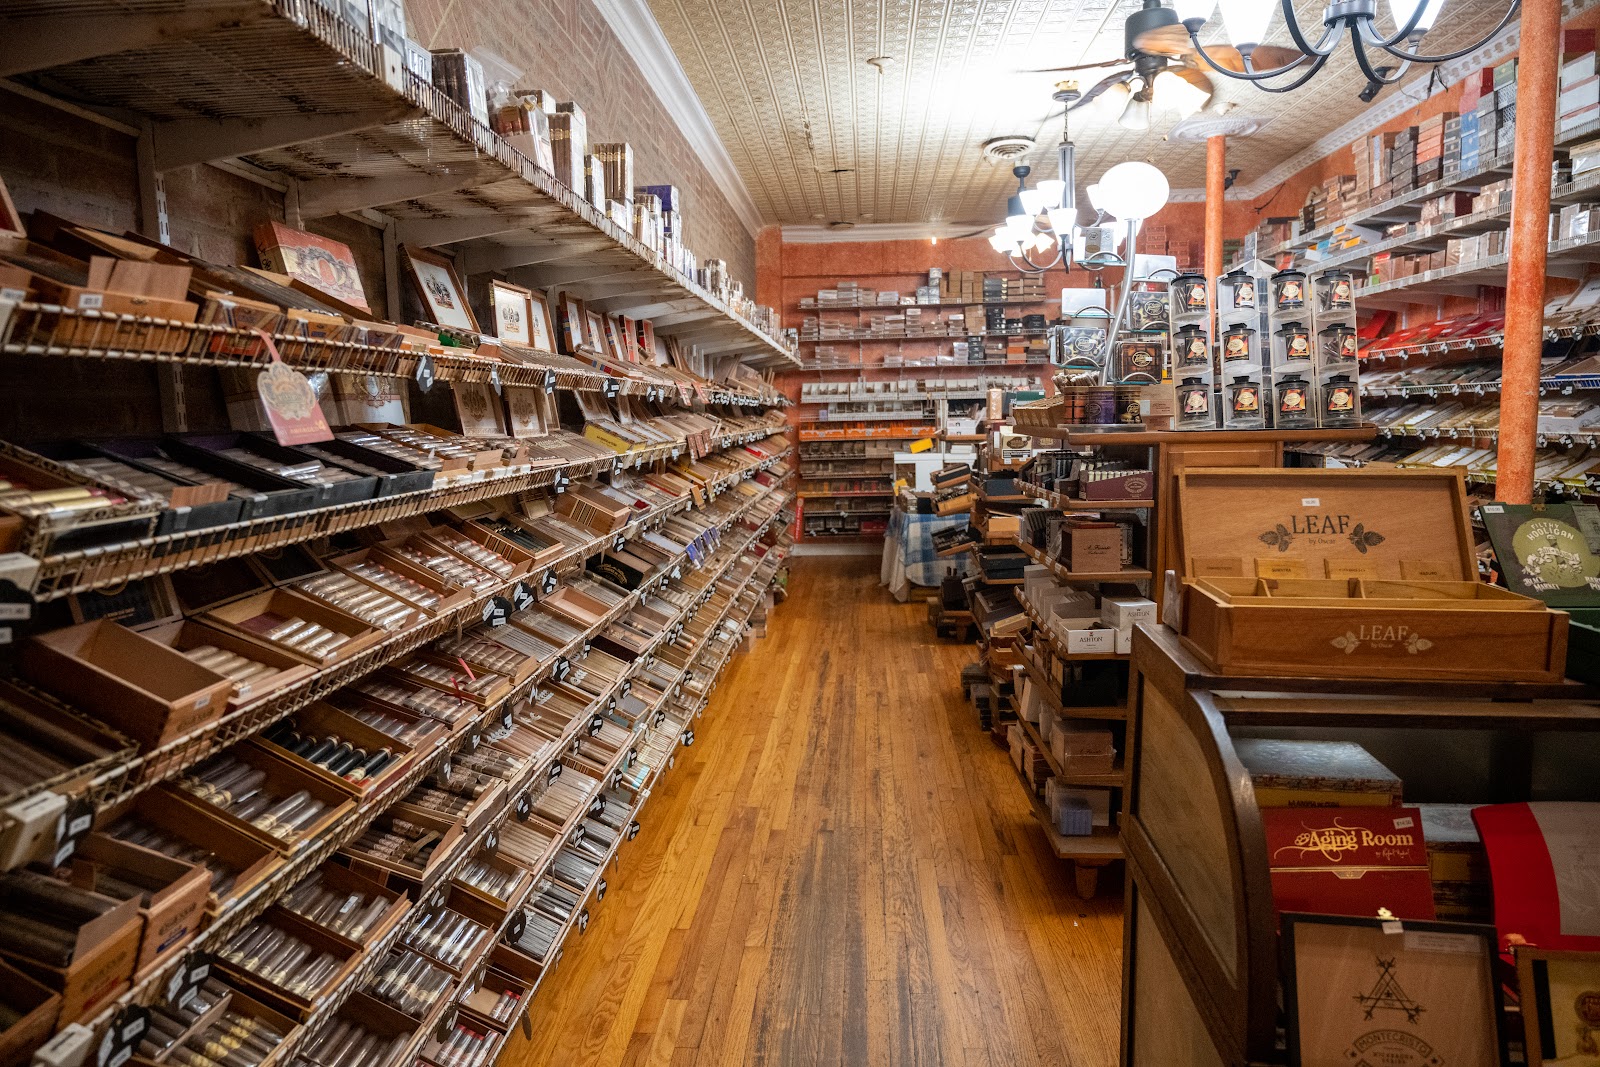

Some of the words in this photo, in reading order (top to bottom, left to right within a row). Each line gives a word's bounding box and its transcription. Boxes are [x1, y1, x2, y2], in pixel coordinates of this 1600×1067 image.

[1290, 514, 1350, 534] LEAF
[1530, 522, 1560, 530] FILTHY
[1526, 527, 1575, 541] HOOLIGAN
[1522, 577, 1546, 587] BLACK
[1533, 583, 1560, 592] MARKET
[1360, 624, 1409, 641] LEAF
[1308, 830, 1359, 852] Aging
[1361, 831, 1414, 846] Room
[1358, 1031, 1430, 1054] MONTECRISTO
